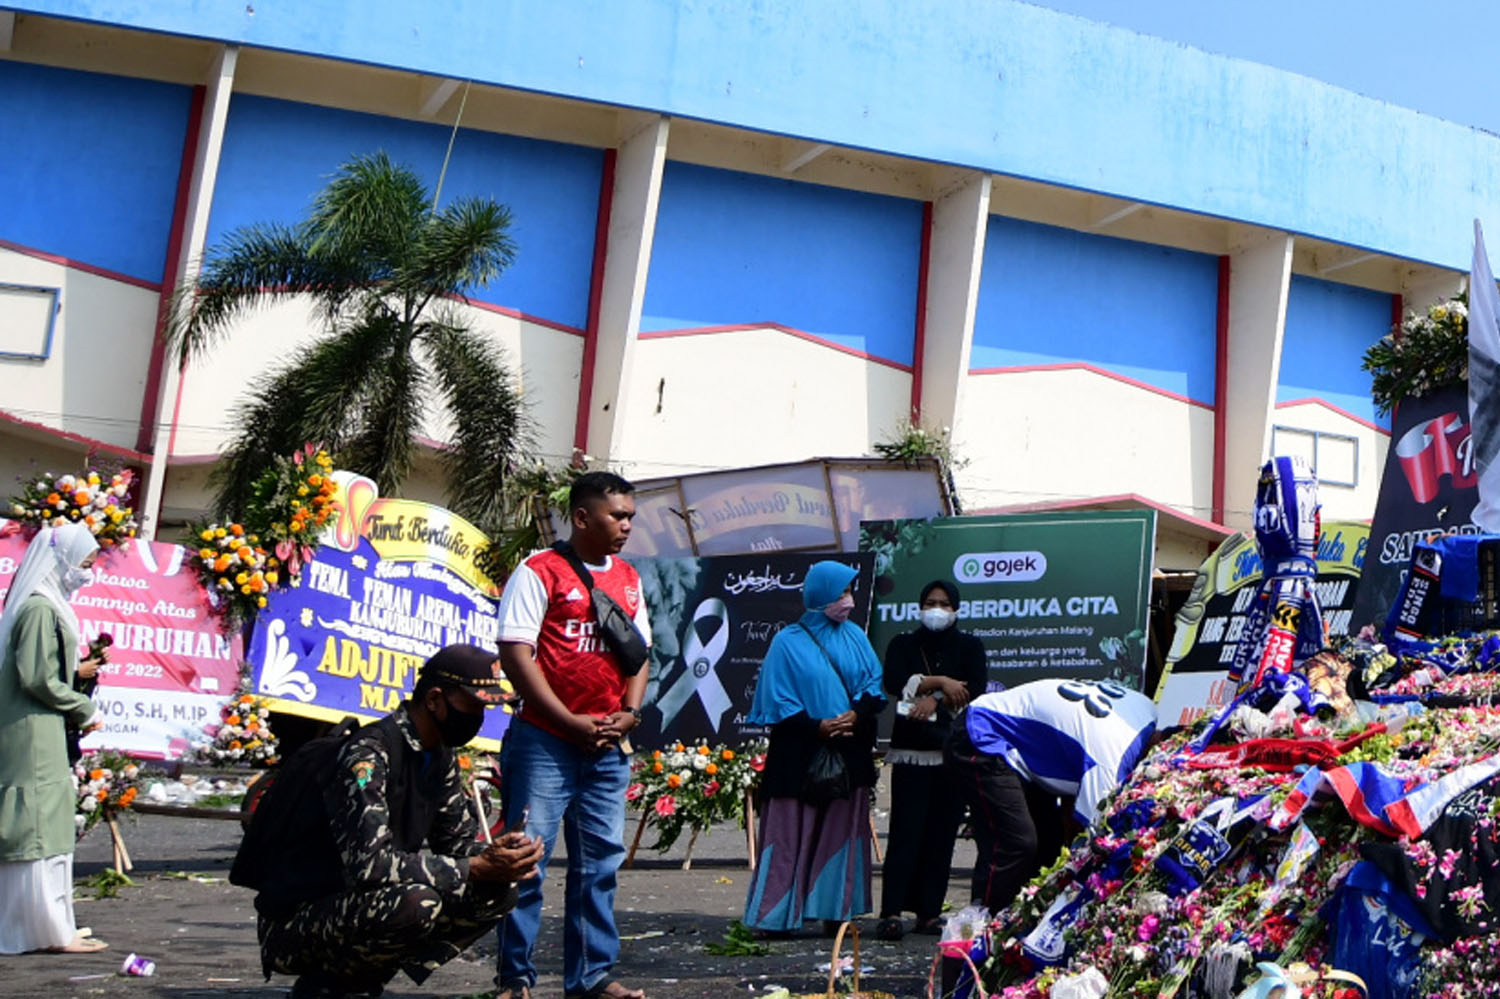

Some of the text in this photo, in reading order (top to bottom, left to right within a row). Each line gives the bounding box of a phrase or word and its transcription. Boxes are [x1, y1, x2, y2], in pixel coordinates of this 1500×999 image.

[366, 514, 405, 542] Turut
[407, 515, 470, 560] Berduka
[983, 556, 1037, 578] gojek
[362, 575, 413, 618] TEMAN
[957, 596, 1064, 619] BERDUKA
[1066, 595, 1119, 616] CITA
[152, 600, 197, 619] Atas
[125, 662, 164, 679] 2022
